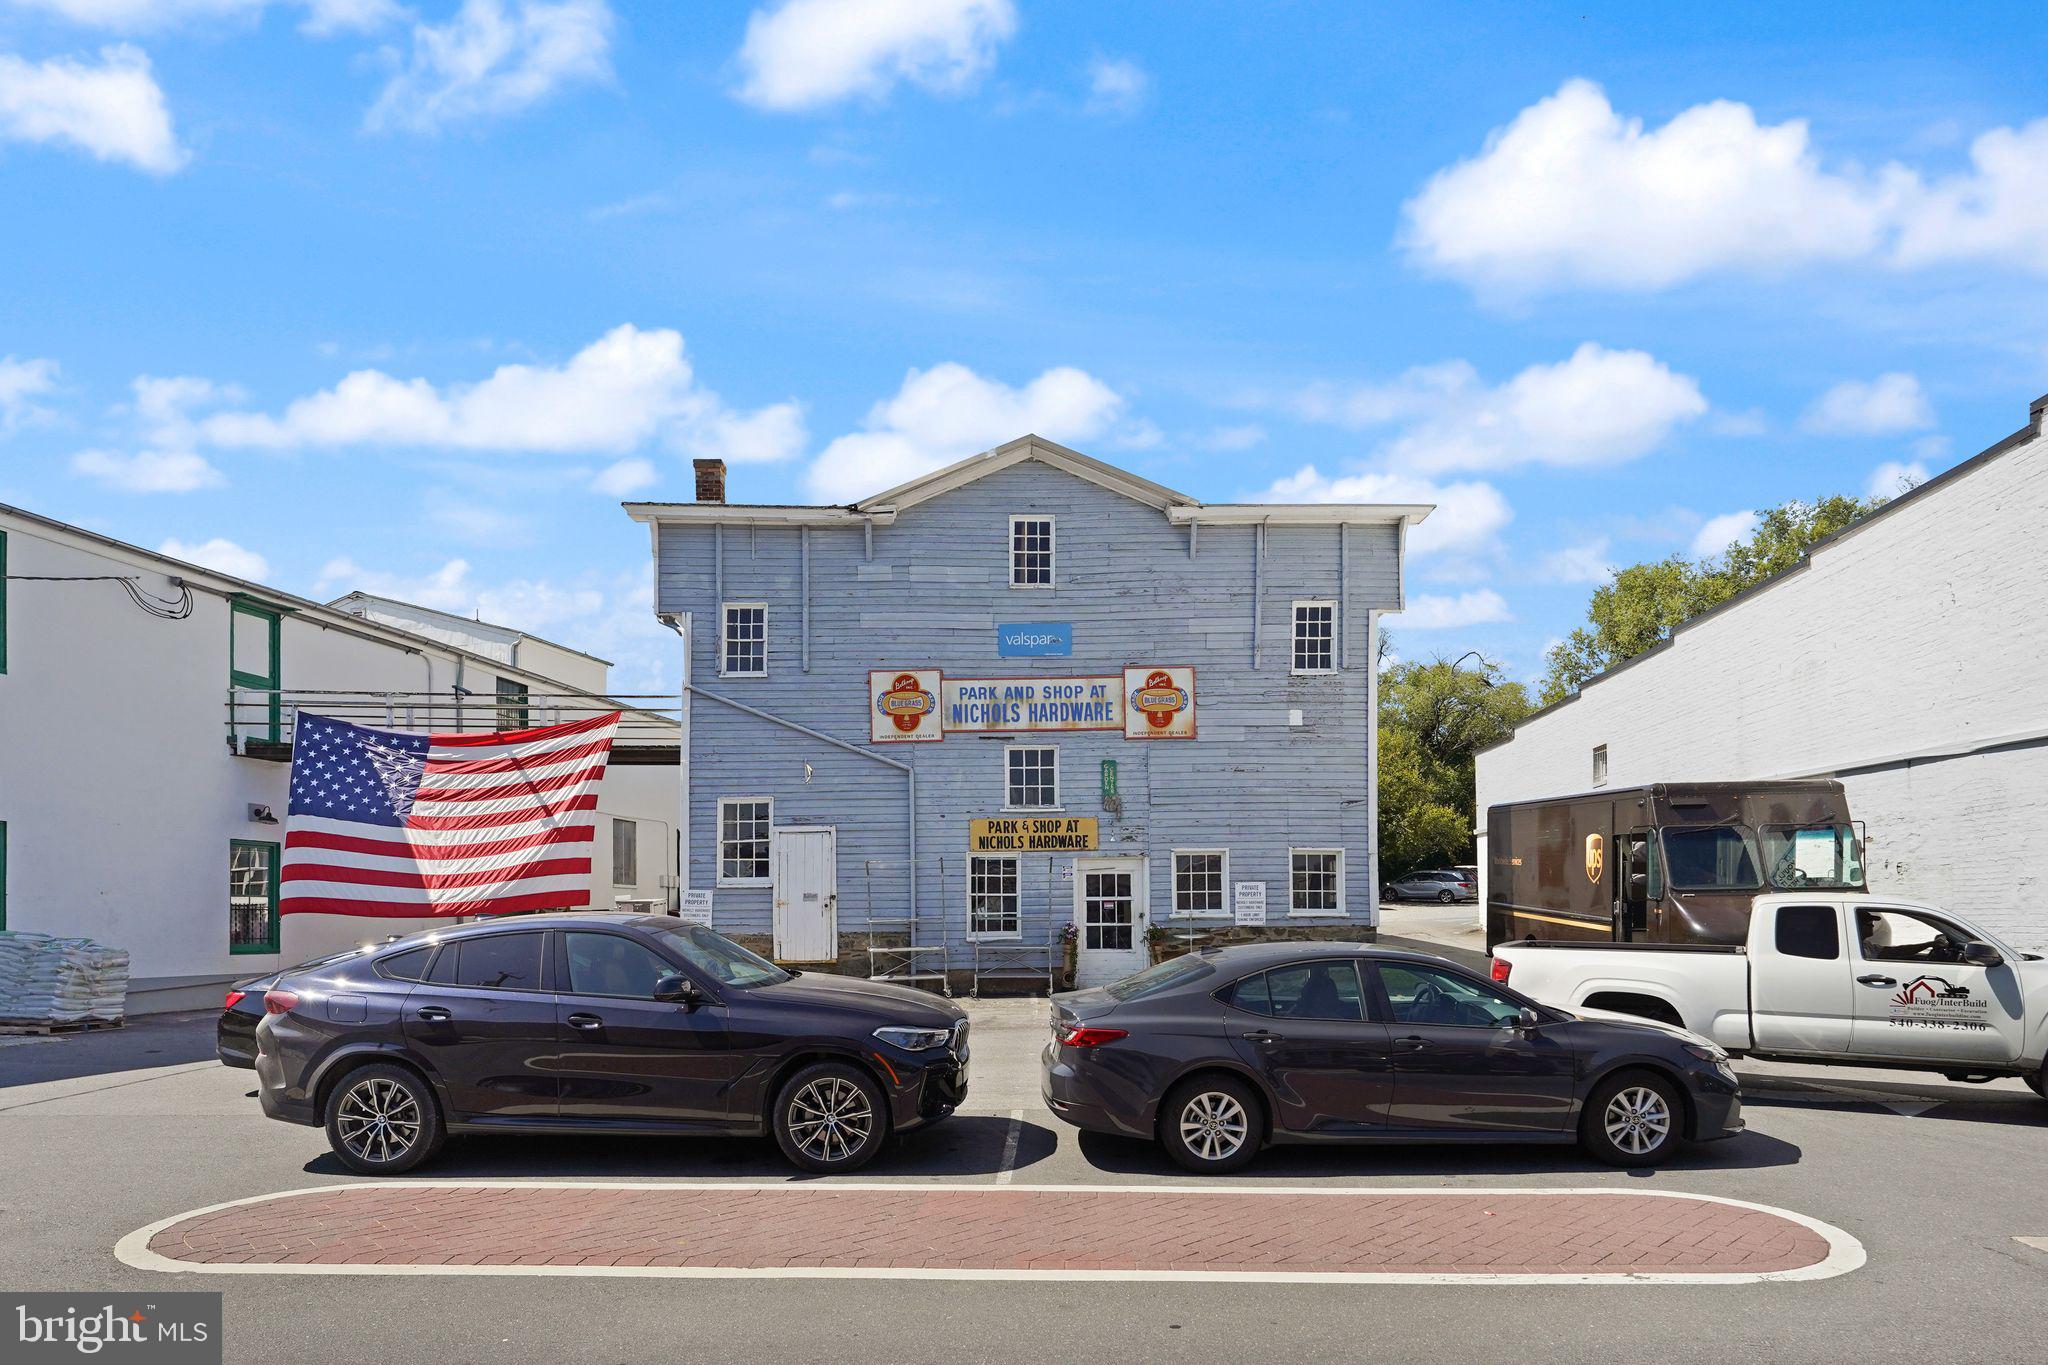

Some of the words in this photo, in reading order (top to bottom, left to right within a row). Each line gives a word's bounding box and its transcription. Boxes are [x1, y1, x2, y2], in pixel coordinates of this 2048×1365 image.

[1005, 632, 1052, 648] valspar
[959, 687, 998, 700] PARK
[1004, 686, 1035, 700] AND
[1043, 685, 1084, 699] SHOP
[1090, 685, 1107, 698] AT
[952, 703, 1021, 723] NICHOLS
[1028, 702, 1113, 722] HARDWARE
[988, 821, 1018, 833] PARK
[1022, 820, 1029, 833] &
[1032, 820, 1061, 833] SHOP
[1066, 820, 1080, 833] AT
[978, 836, 1024, 849] NICHOLS
[1029, 835, 1088, 848] HARDWARE
[1588, 848, 1602, 876] ups
[1914, 996, 1987, 1008] Fuog/InterBuild
[1889, 1018, 1986, 1031] 540-338-2306
